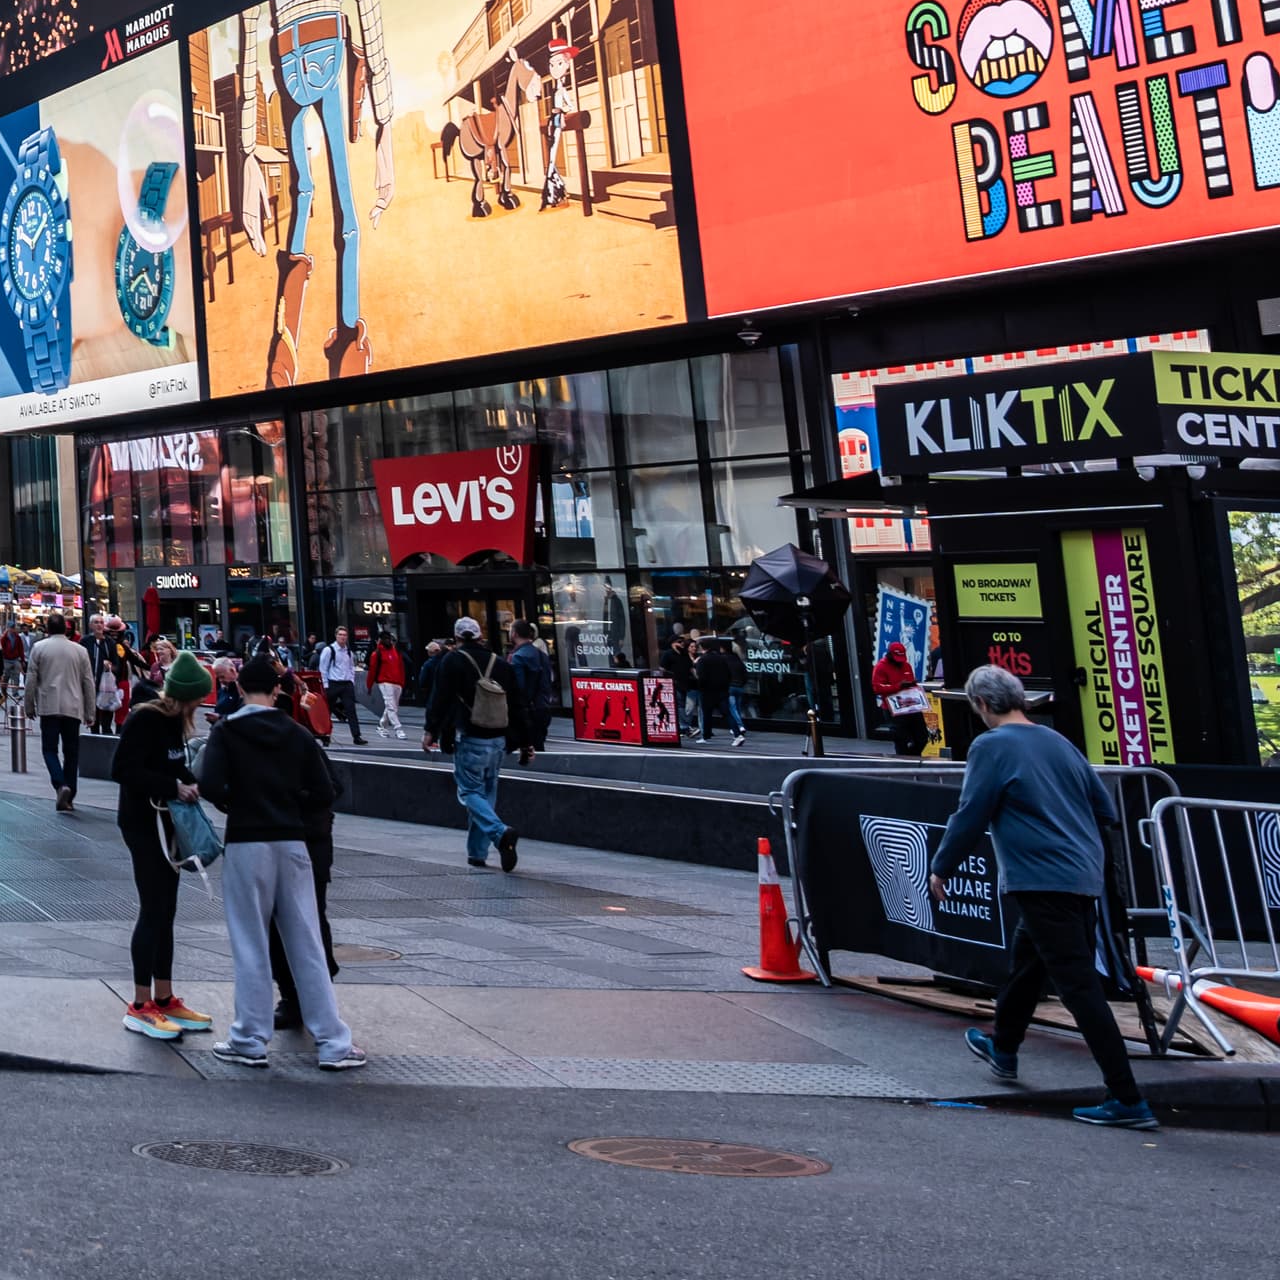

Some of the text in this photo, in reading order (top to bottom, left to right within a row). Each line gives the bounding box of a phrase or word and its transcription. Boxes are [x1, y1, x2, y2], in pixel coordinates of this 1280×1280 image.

[125, 3, 174, 37] MARRIOTT
[126, 24, 169, 54] MARQUIS
[20, 378, 188, 418] AVAILABLE AT SWATCH @FlikFlak
[905, 378, 1123, 457] KLIKTIX
[156, 572, 193, 590] swatch
[962, 578, 1032, 589] NO BROADWAY
[979, 593, 1016, 602] TICKETS
[578, 633, 609, 643] BAGGY
[992, 632, 1022, 642] GO TO
[1105, 574, 1136, 690] CENTER
[576, 646, 614, 656] SEASON
[1123, 534, 1169, 753] SQUARE TIMES
[747, 649, 784, 660] BAGGY
[988, 645, 1032, 675] tkts
[745, 662, 790, 673] SEASON
[1085, 601, 1115, 733] OFFICIAL
[605, 682, 634, 692] CHARTS.
[939, 901, 991, 921] ALLIANCE
